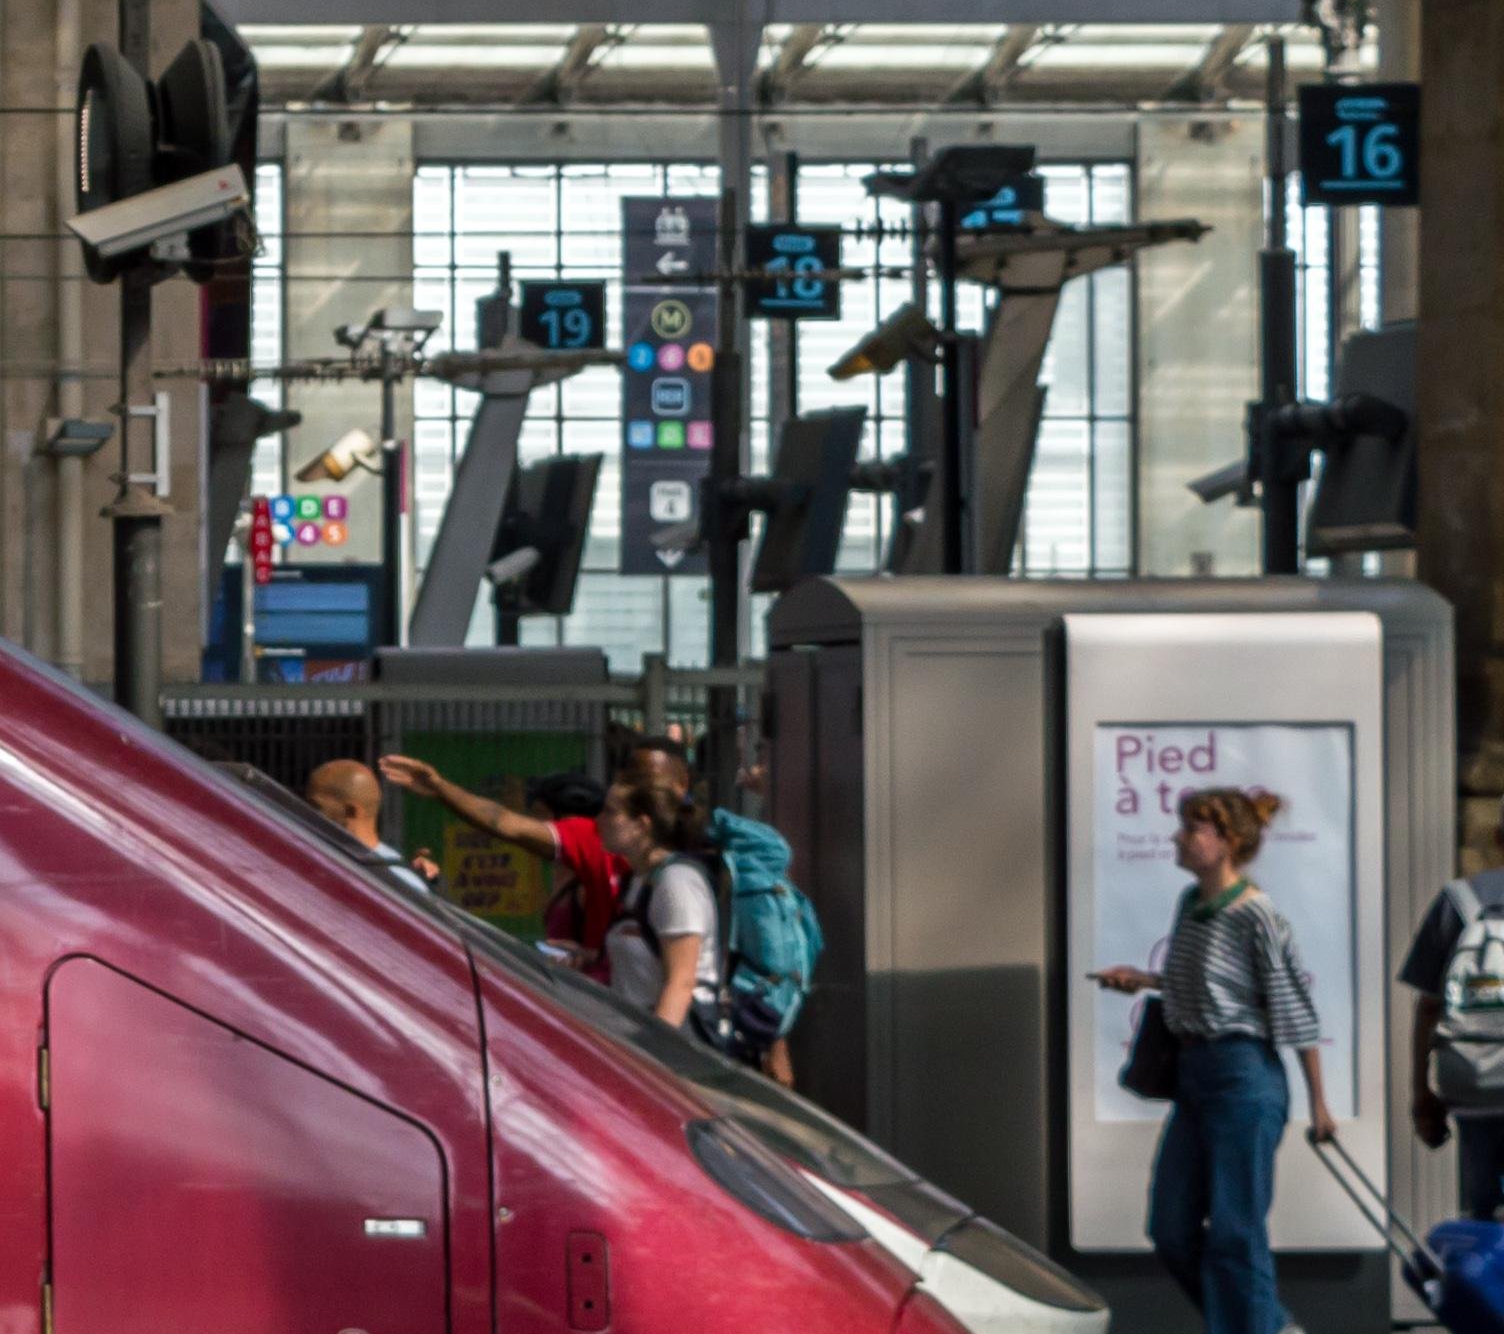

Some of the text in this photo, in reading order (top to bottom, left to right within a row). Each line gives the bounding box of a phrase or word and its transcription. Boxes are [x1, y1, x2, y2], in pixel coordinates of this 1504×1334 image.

[1326, 123, 1403, 178] 16
[764, 256, 823, 298] 18
[537, 308, 592, 347] 19
[301, 499, 319, 517] D
[300, 526, 342, 543] 4 5
[1116, 731, 1216, 774] Pied
[1115, 775, 1140, 815] à
